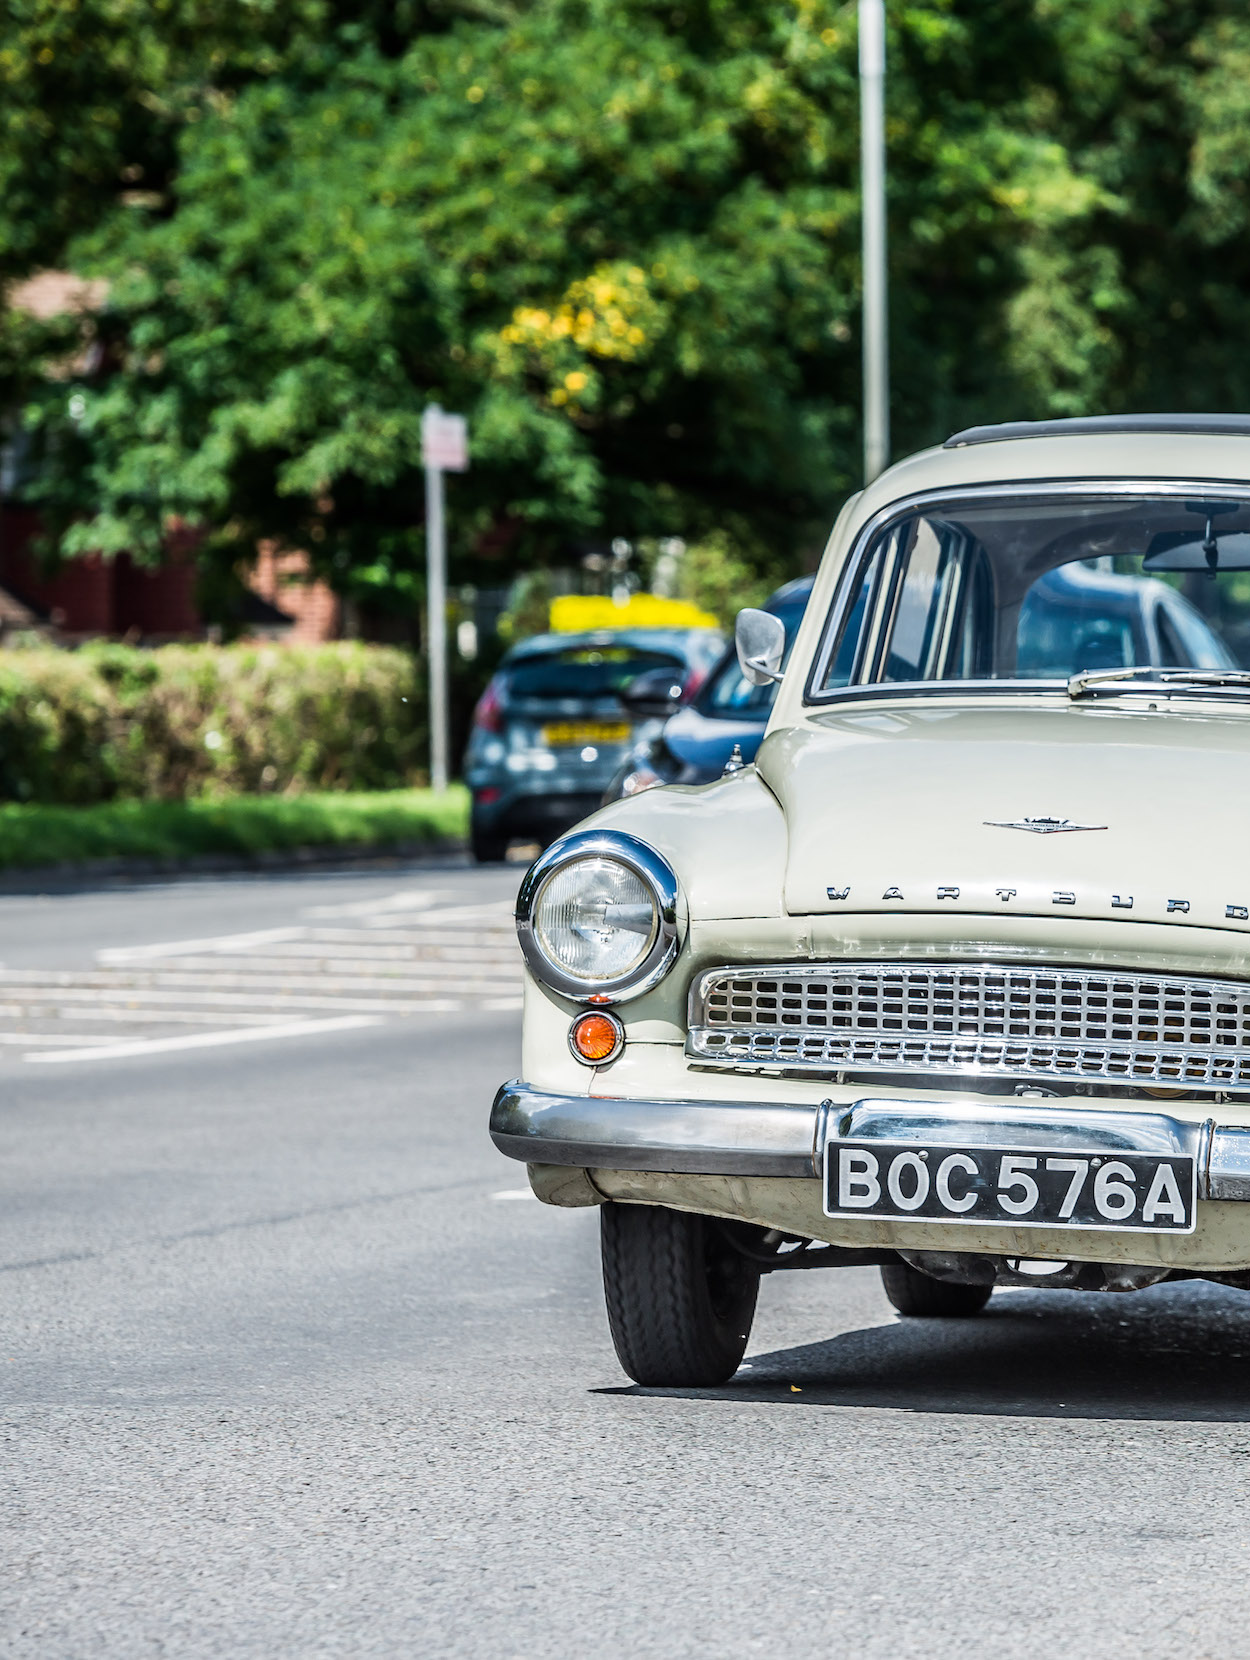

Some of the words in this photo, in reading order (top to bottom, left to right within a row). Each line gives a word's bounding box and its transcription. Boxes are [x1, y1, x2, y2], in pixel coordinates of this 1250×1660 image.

[827, 887, 1249, 920] WARTBURG
[838, 1148, 979, 1213] BOC
[996, 1155, 1186, 1224] 576A
